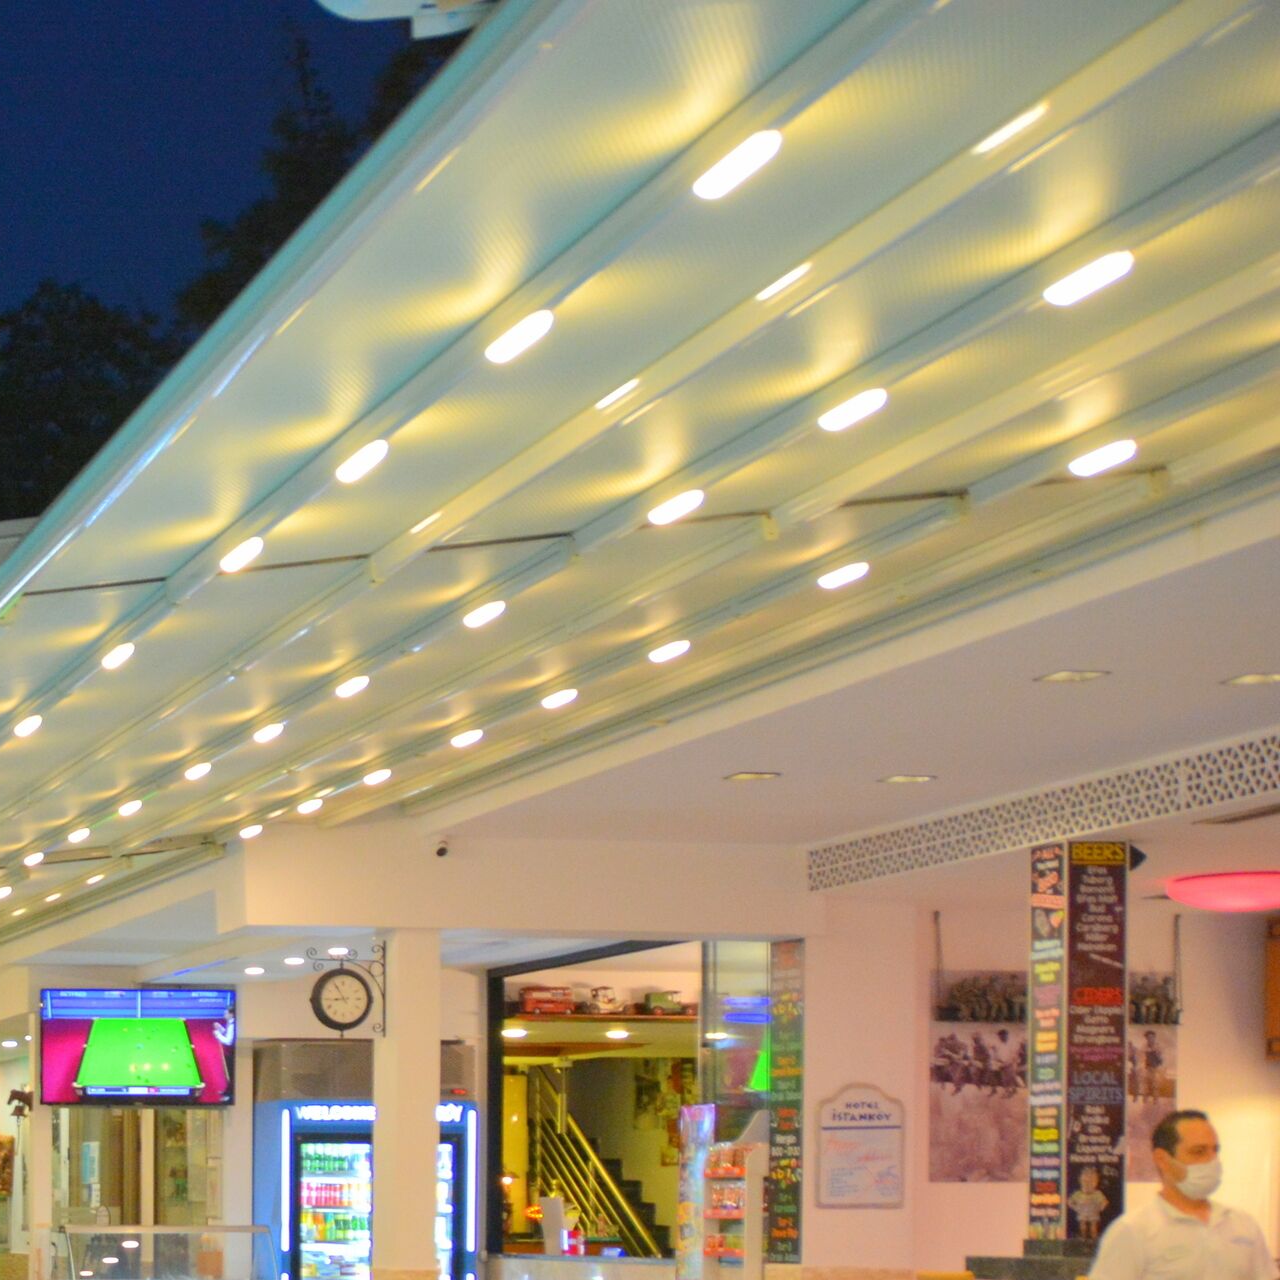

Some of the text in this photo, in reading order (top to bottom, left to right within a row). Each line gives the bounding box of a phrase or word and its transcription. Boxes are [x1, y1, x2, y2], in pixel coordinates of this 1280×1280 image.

[1071, 842, 1125, 861] BEERS
[1073, 1072, 1119, 1085] LOCAL
[1070, 1087, 1124, 1101] SPIRITS
[295, 1105, 376, 1121] WELCOME
